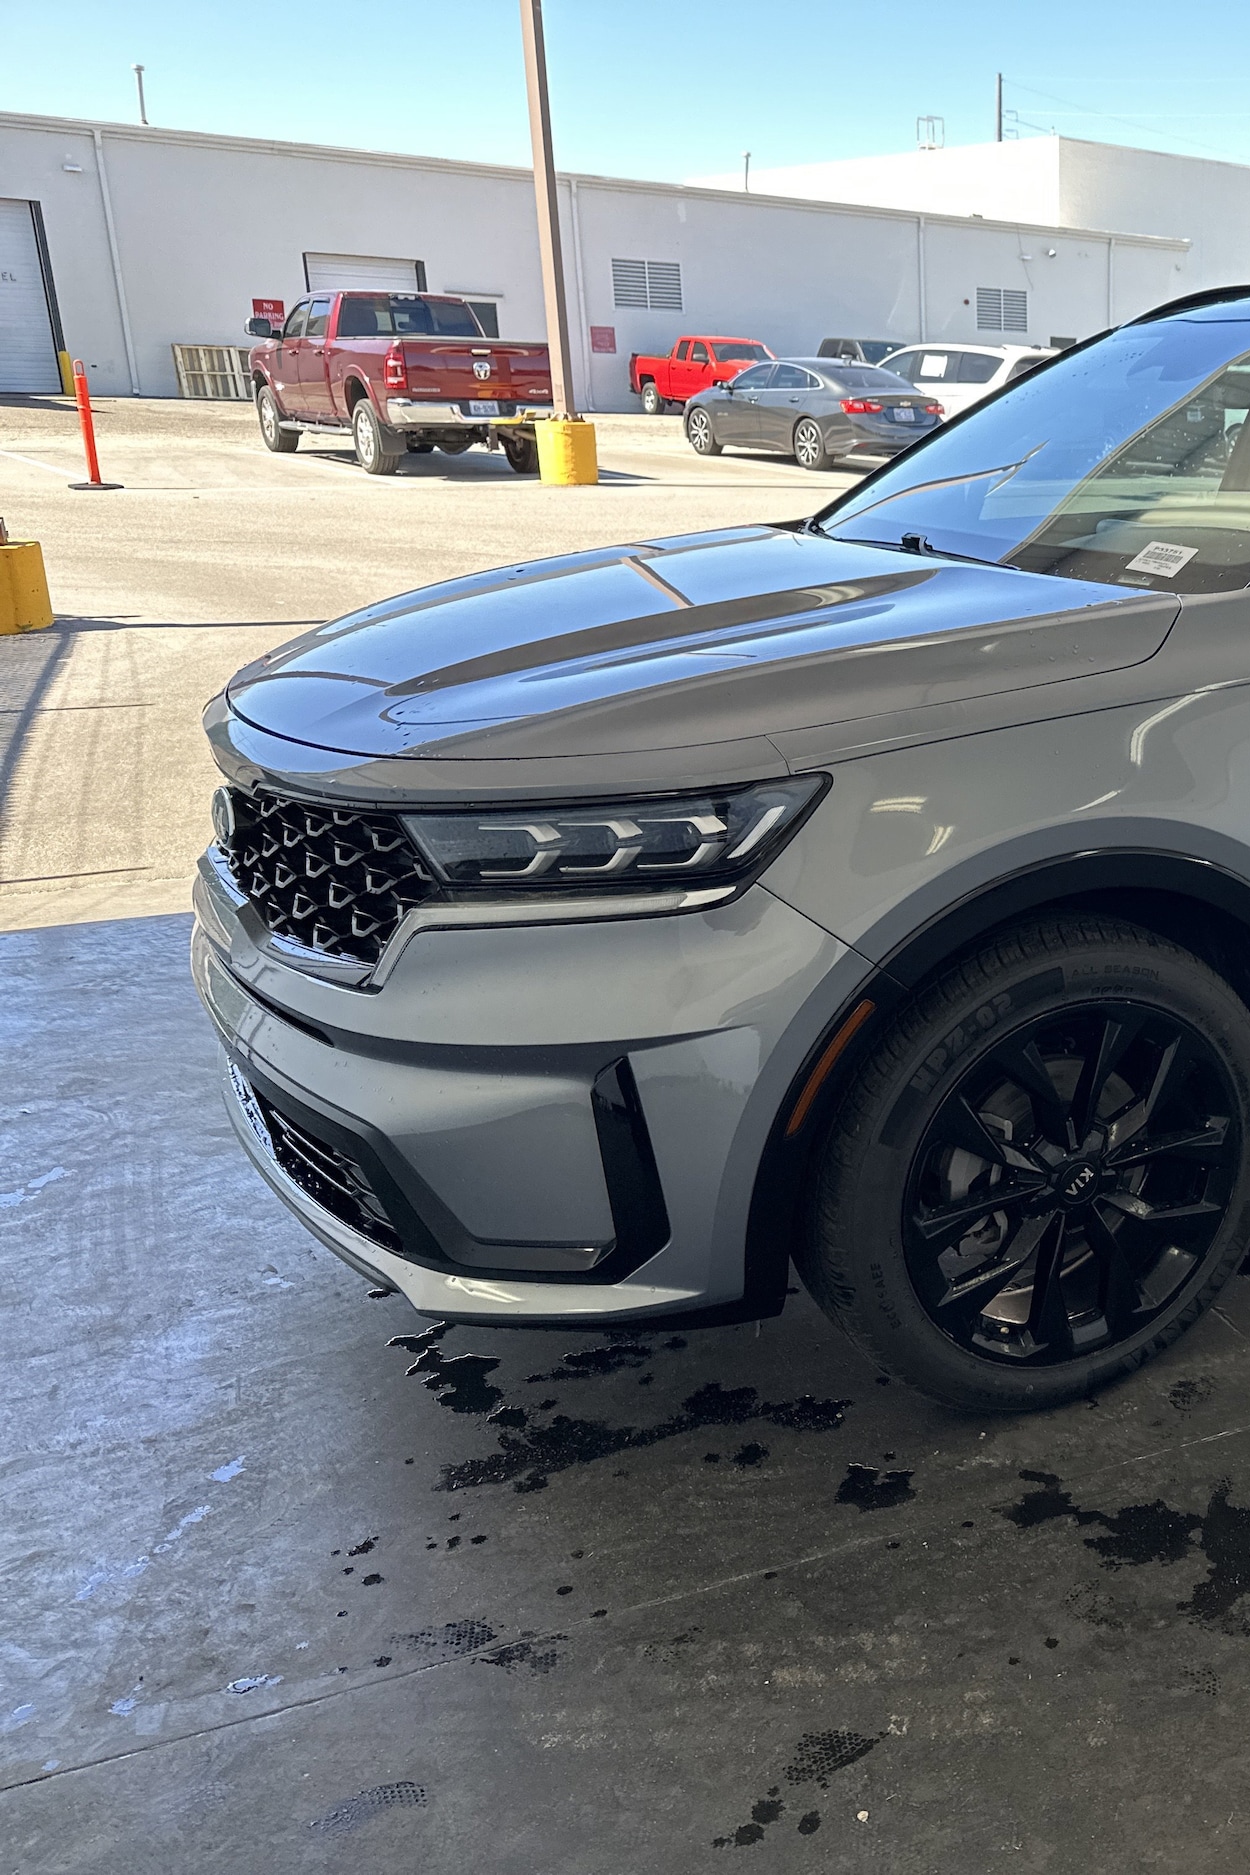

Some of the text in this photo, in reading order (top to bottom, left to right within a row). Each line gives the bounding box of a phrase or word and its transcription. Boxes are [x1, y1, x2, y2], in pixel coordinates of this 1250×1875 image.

[262, 302, 274, 311] NO
[254, 311, 284, 321] PARKING
[1070, 963, 1162, 981] ALL SEASON
[1065, 1167, 1094, 1196] KIA
